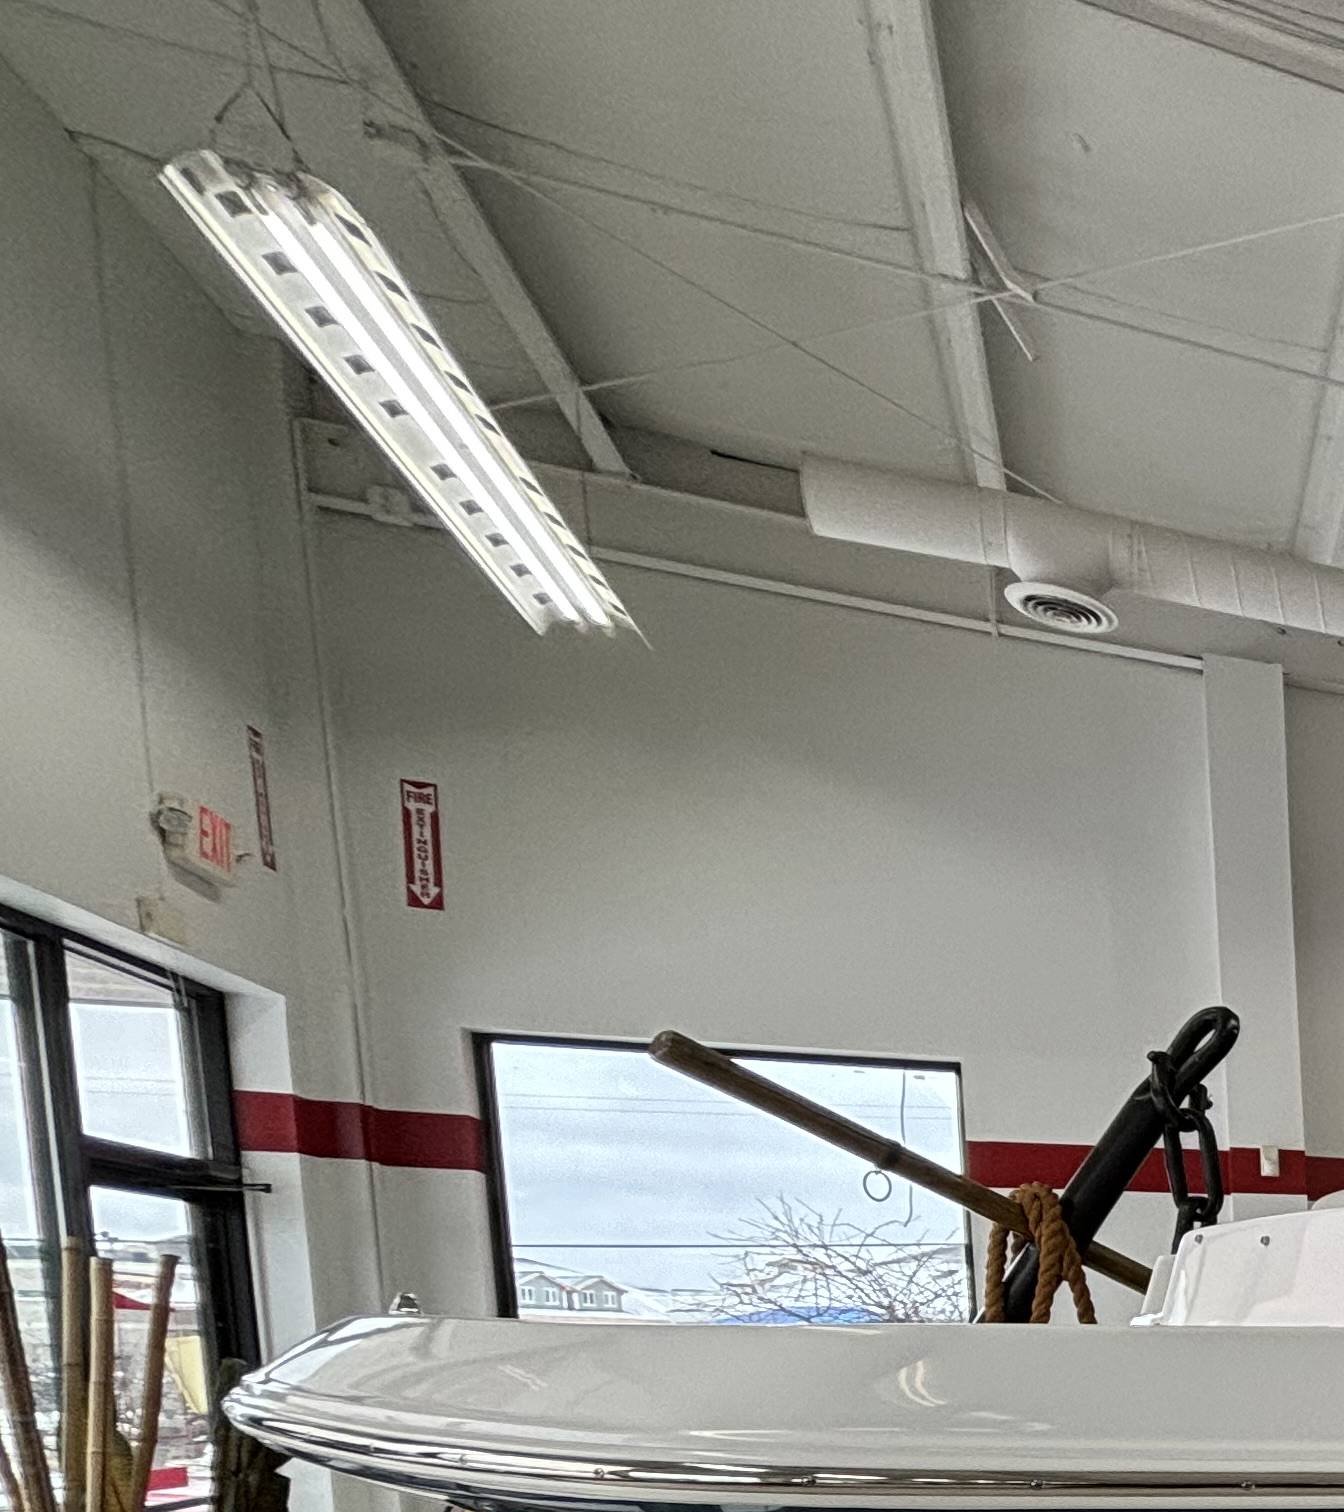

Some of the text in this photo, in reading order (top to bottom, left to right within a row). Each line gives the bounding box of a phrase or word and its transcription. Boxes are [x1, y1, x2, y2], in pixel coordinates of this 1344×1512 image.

[405, 790, 433, 805] FIRE
[200, 805, 231, 874] EXIT
[414, 808, 432, 899] EXTINGUISHER
